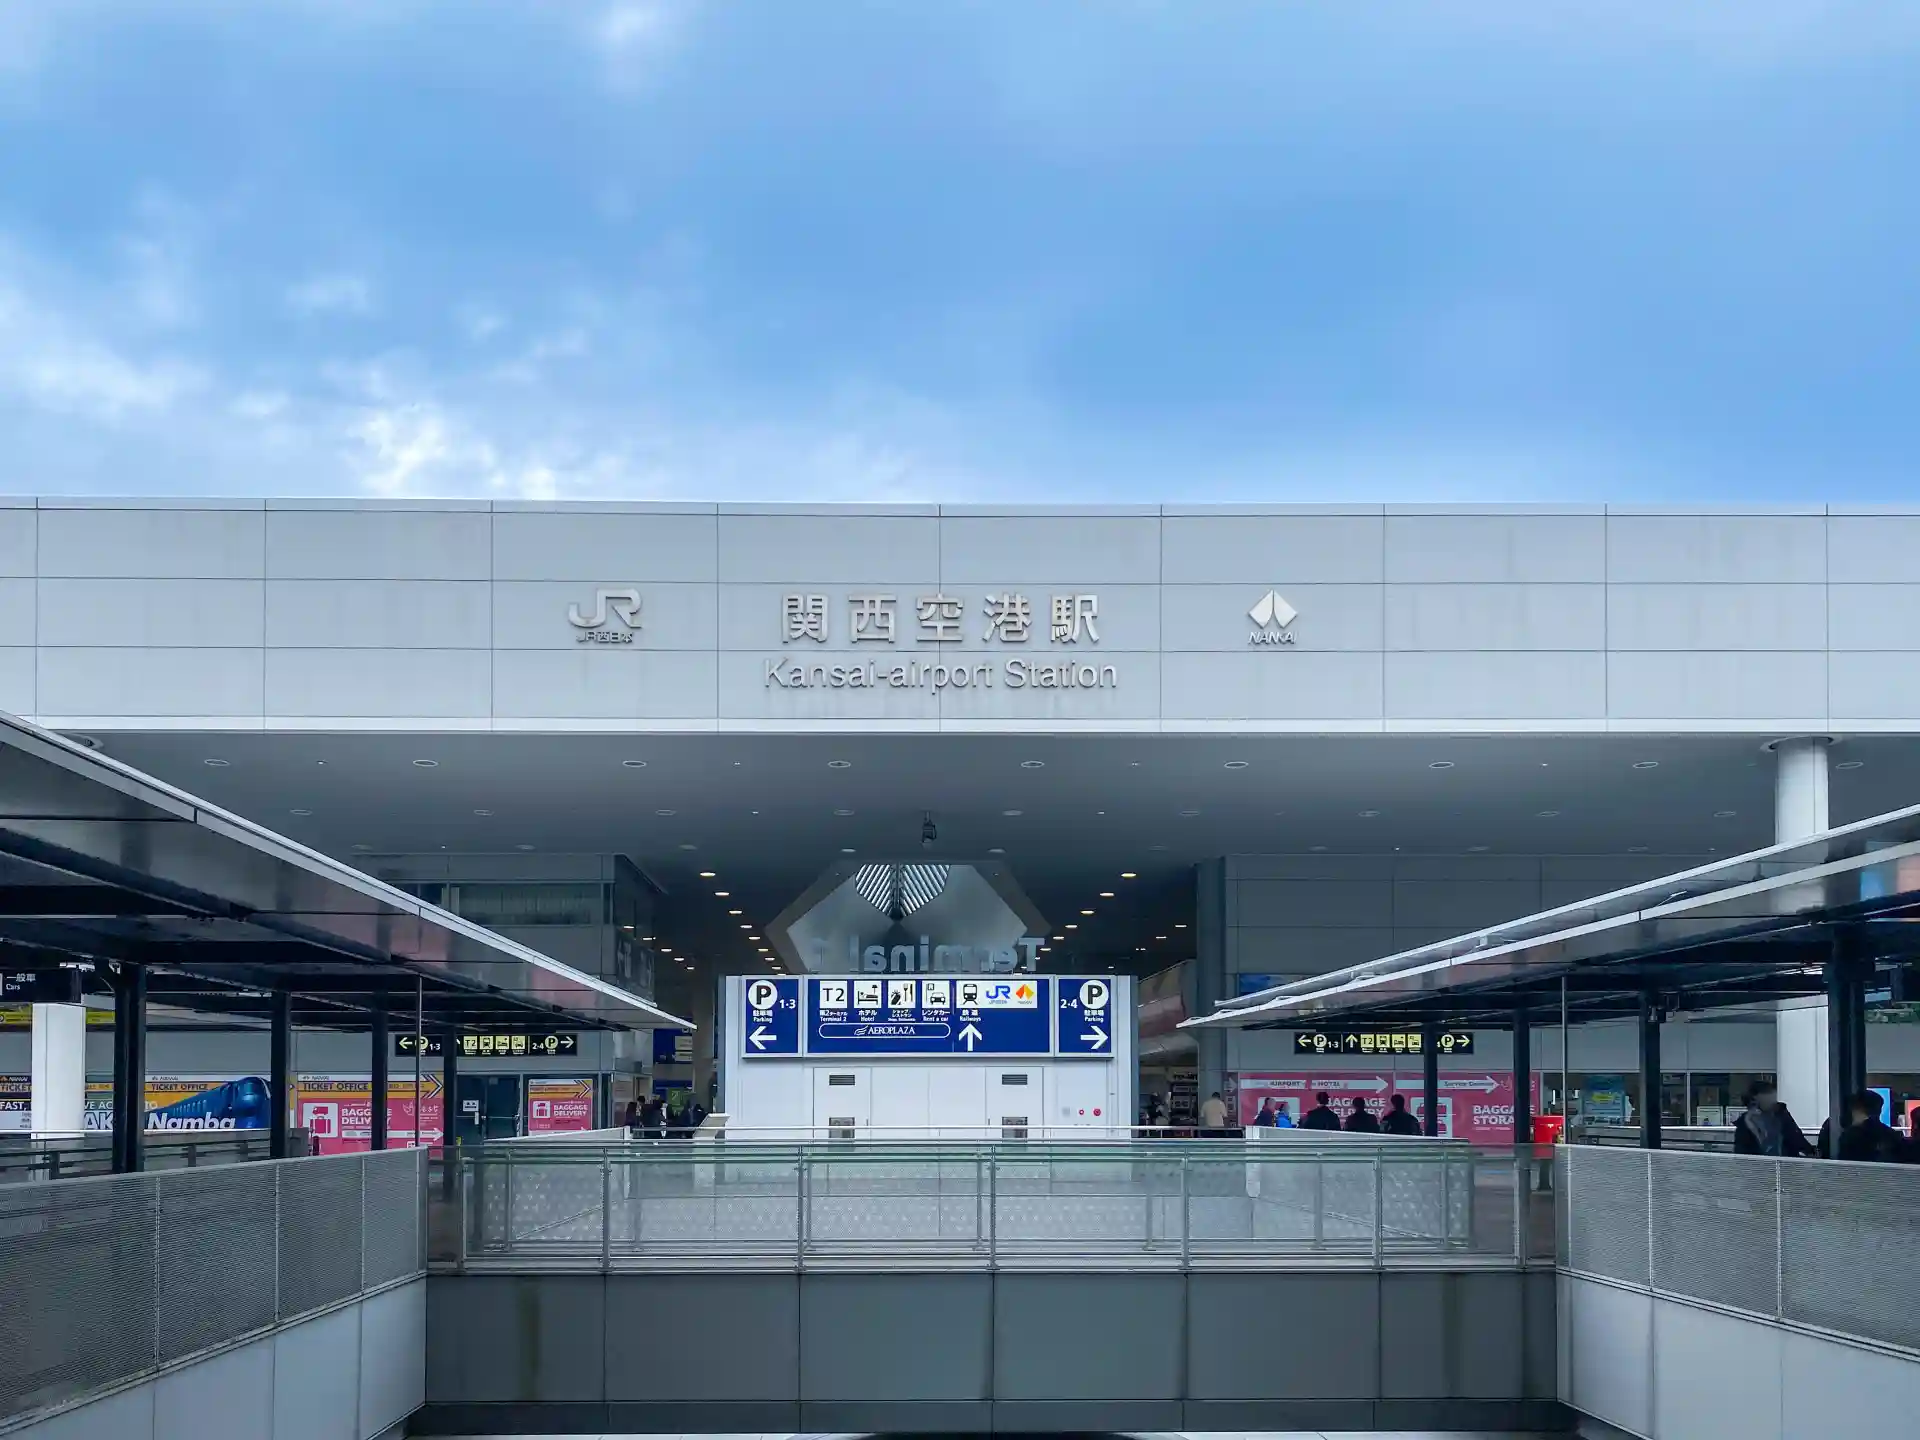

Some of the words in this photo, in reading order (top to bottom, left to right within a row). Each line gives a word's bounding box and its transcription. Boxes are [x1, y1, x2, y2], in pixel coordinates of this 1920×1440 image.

[569, 588, 642, 628] JR
[781, 593, 1100, 644] 関西空港駅
[576, 631, 633, 643] JR西日本
[1248, 631, 1297, 645] NANKAI
[765, 658, 993, 695] Kansai-airport
[1004, 658, 1118, 689] Station
[6, 973, 36, 982] 一般車
[986, 986, 1010, 1000] JR
[868, 1026, 916, 1035] AEROPLAZA
[148, 1112, 236, 1129] Namba
